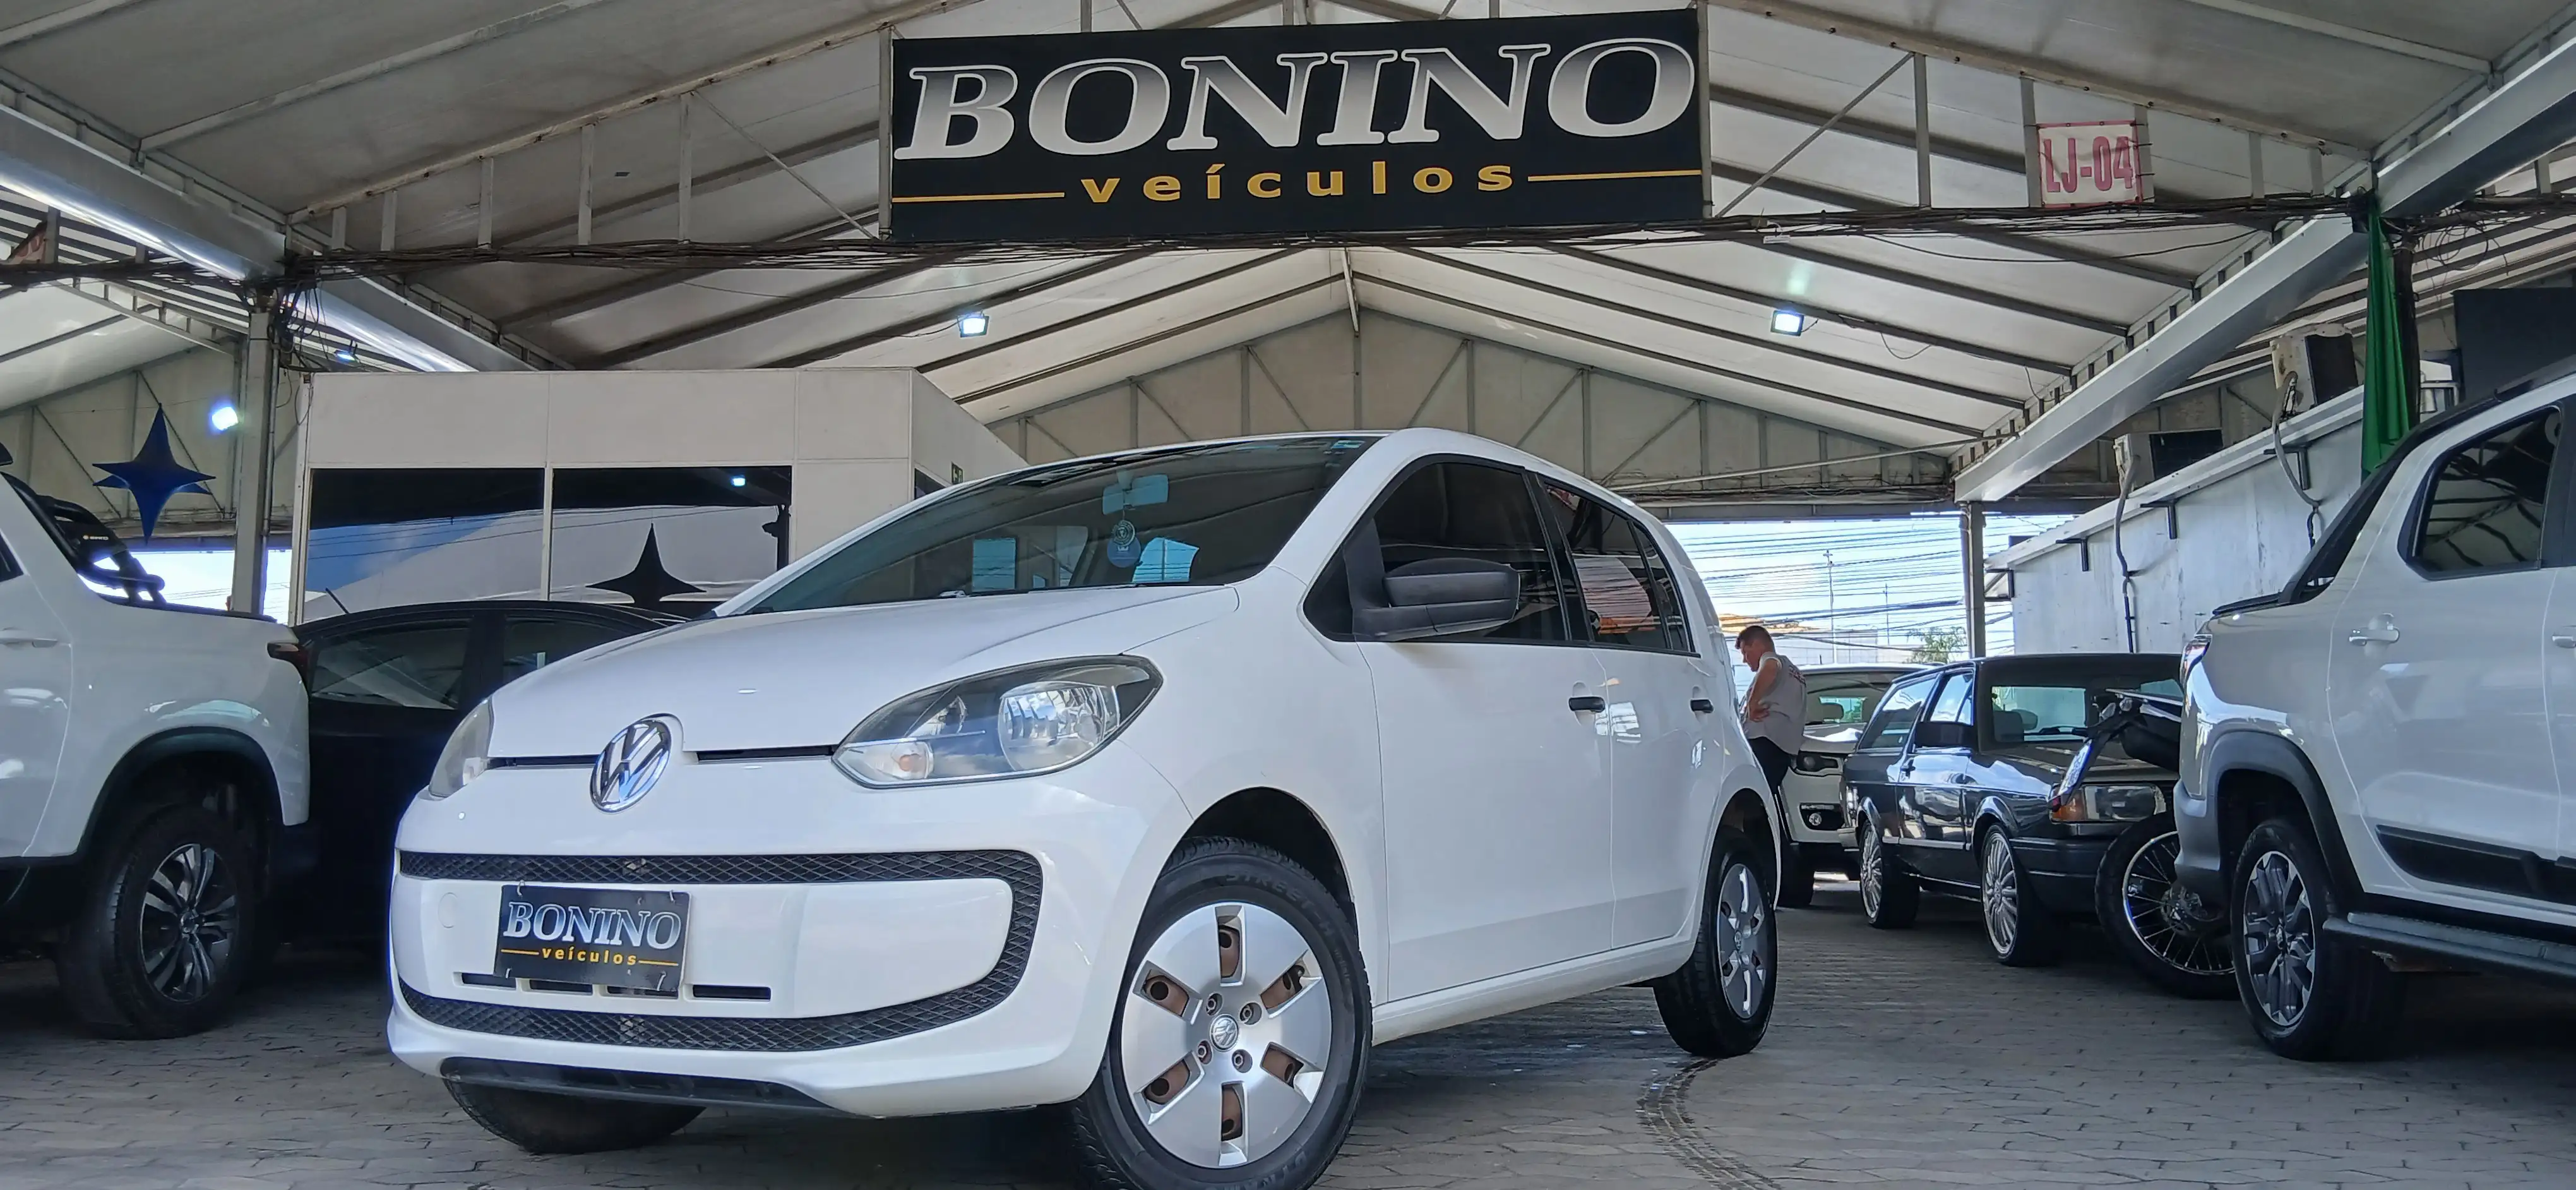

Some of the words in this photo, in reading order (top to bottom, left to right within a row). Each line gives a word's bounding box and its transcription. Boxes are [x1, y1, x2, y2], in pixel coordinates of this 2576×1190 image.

[893, 37, 1696, 160] BONINO
[1080, 160, 1514, 204] veículos
[2043, 135, 2133, 193] LJ-04
[503, 901, 682, 950] BONINO
[542, 946, 638, 966] veículos
